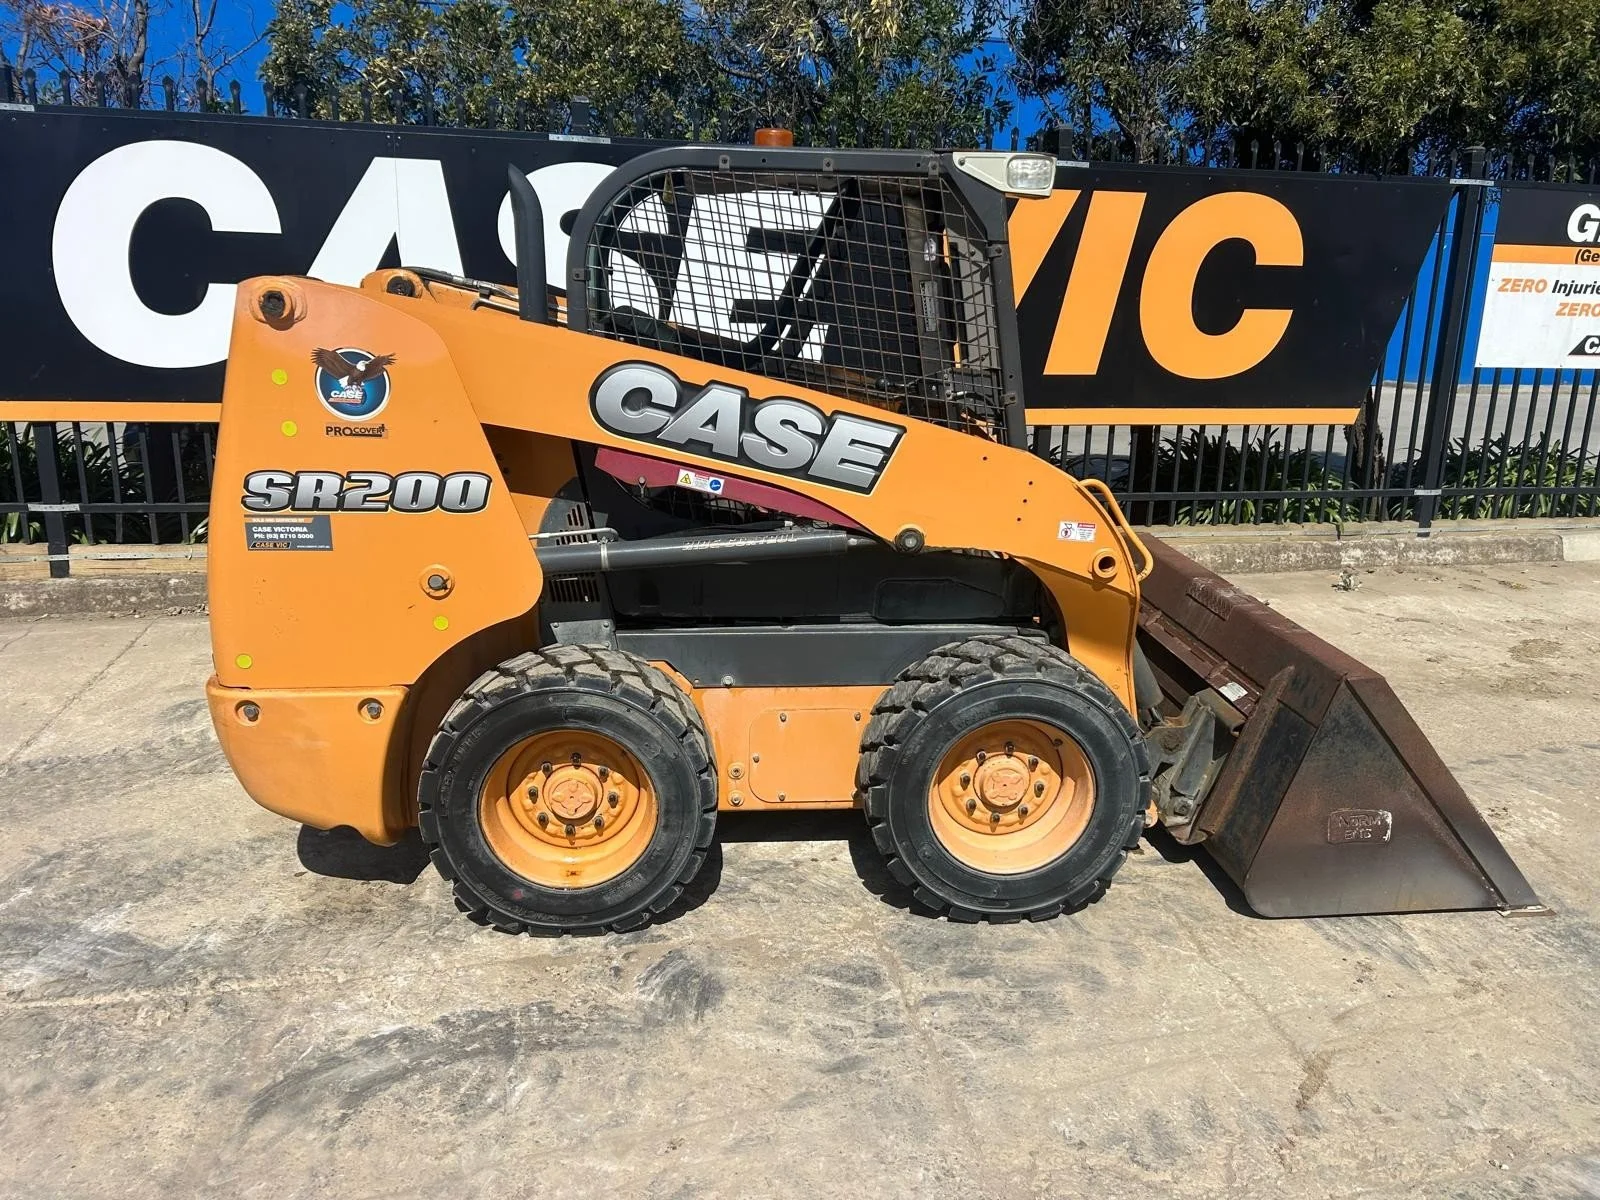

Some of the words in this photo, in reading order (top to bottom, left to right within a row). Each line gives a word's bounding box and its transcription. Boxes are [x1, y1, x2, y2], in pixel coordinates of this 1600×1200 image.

[1567, 203, 1600, 243] G
[1497, 278, 1548, 293] ZERO
[330, 390, 364, 399] CASE
[592, 362, 905, 492] CASE
[241, 469, 492, 512] SR200
